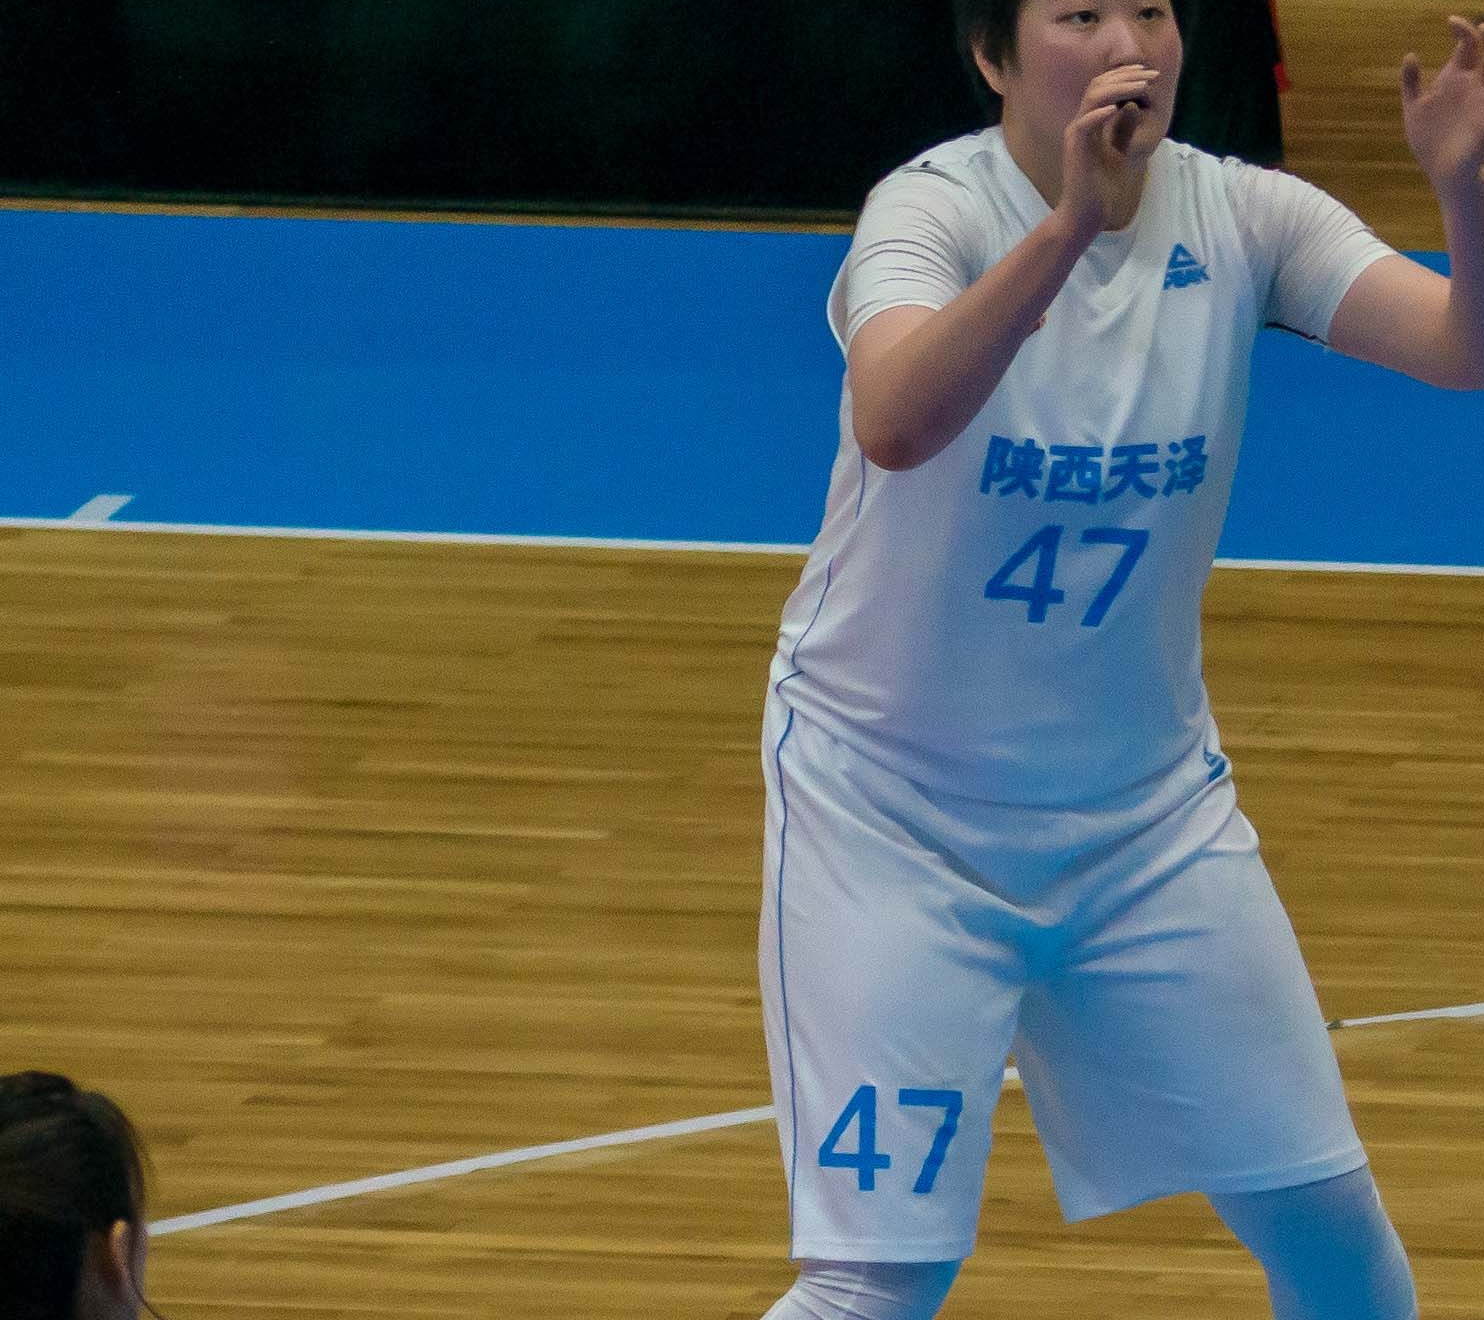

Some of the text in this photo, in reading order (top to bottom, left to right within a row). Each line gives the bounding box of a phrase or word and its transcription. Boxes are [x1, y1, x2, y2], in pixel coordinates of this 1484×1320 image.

[980, 435, 1207, 505] 陕西天泽
[984, 525, 1150, 627] 47
[818, 1084, 963, 1194] 47
